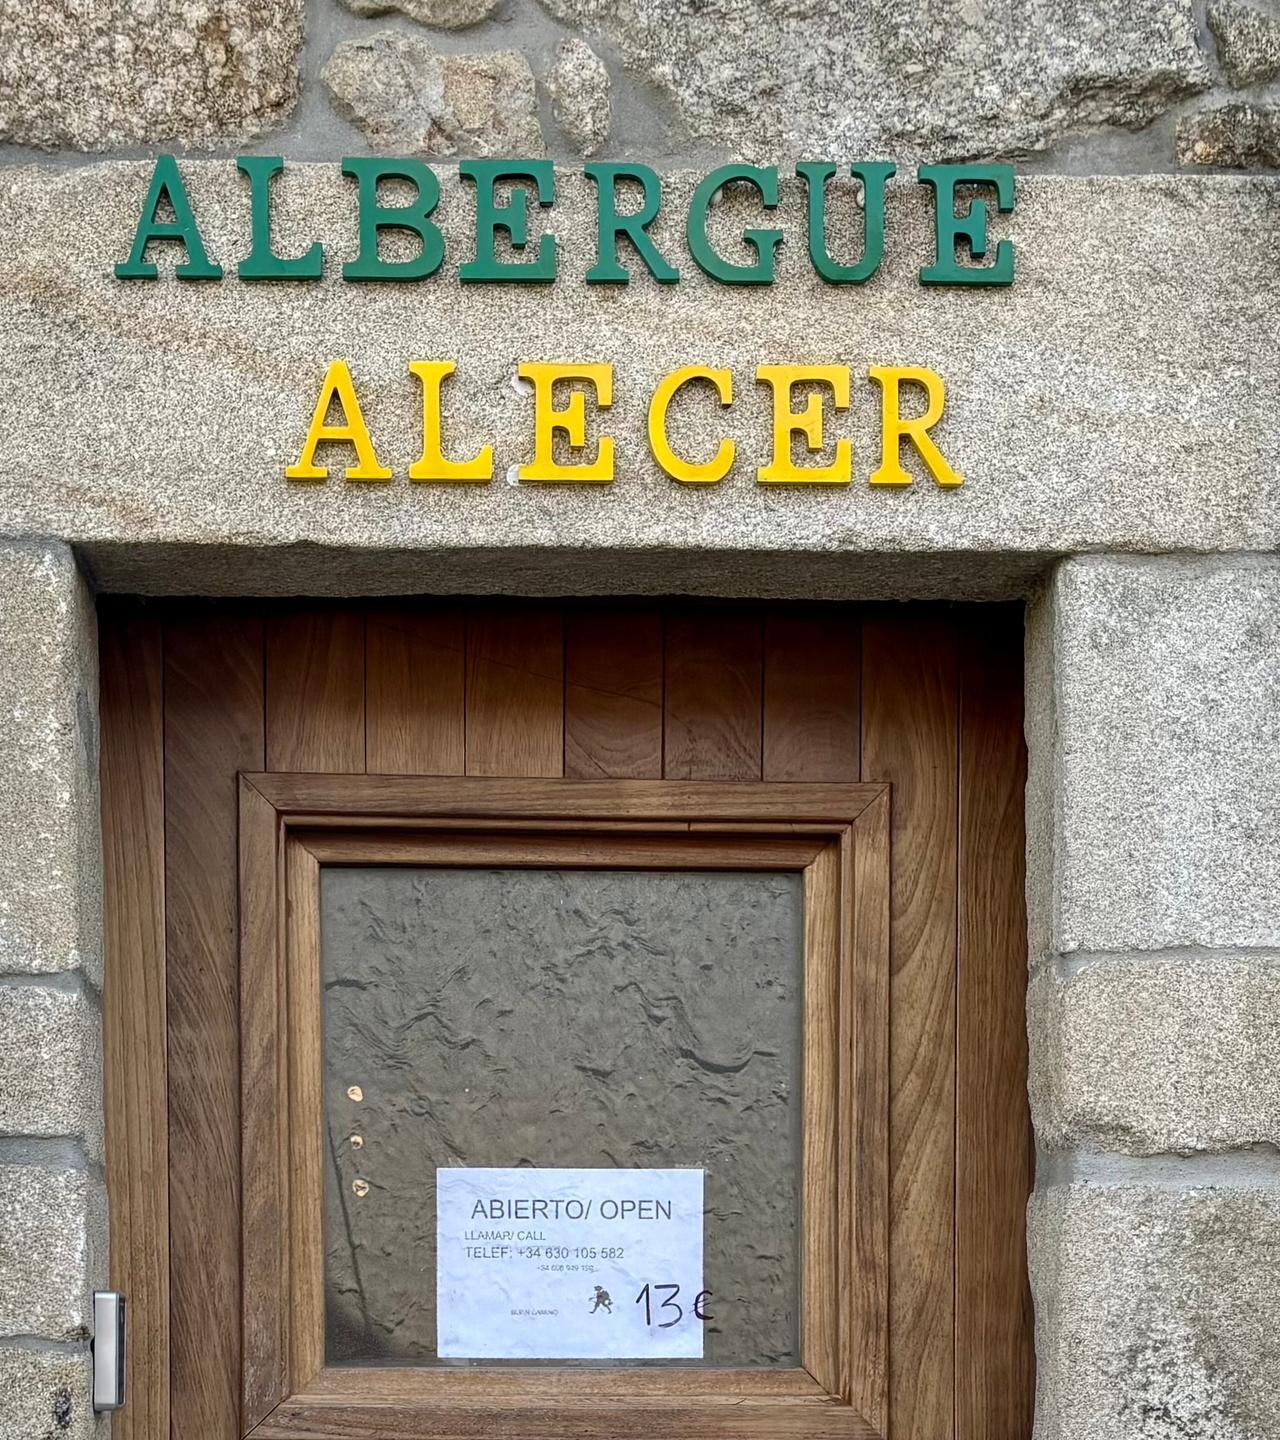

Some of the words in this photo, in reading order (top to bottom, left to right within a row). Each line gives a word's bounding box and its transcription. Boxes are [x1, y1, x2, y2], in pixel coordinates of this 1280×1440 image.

[114, 153, 1015, 286] ALBERGUE
[285, 359, 963, 488] ALECER
[471, 1199, 593, 1220] ABIERTO/
[600, 1199, 672, 1220] OPEN
[517, 1231, 546, 1241] CALL
[465, 1246, 513, 1259] TELEF:
[517, 1247, 541, 1259] +34
[545, 1247, 569, 1259] 630
[575, 1247, 596, 1259] 105
[600, 1247, 624, 1259] 582
